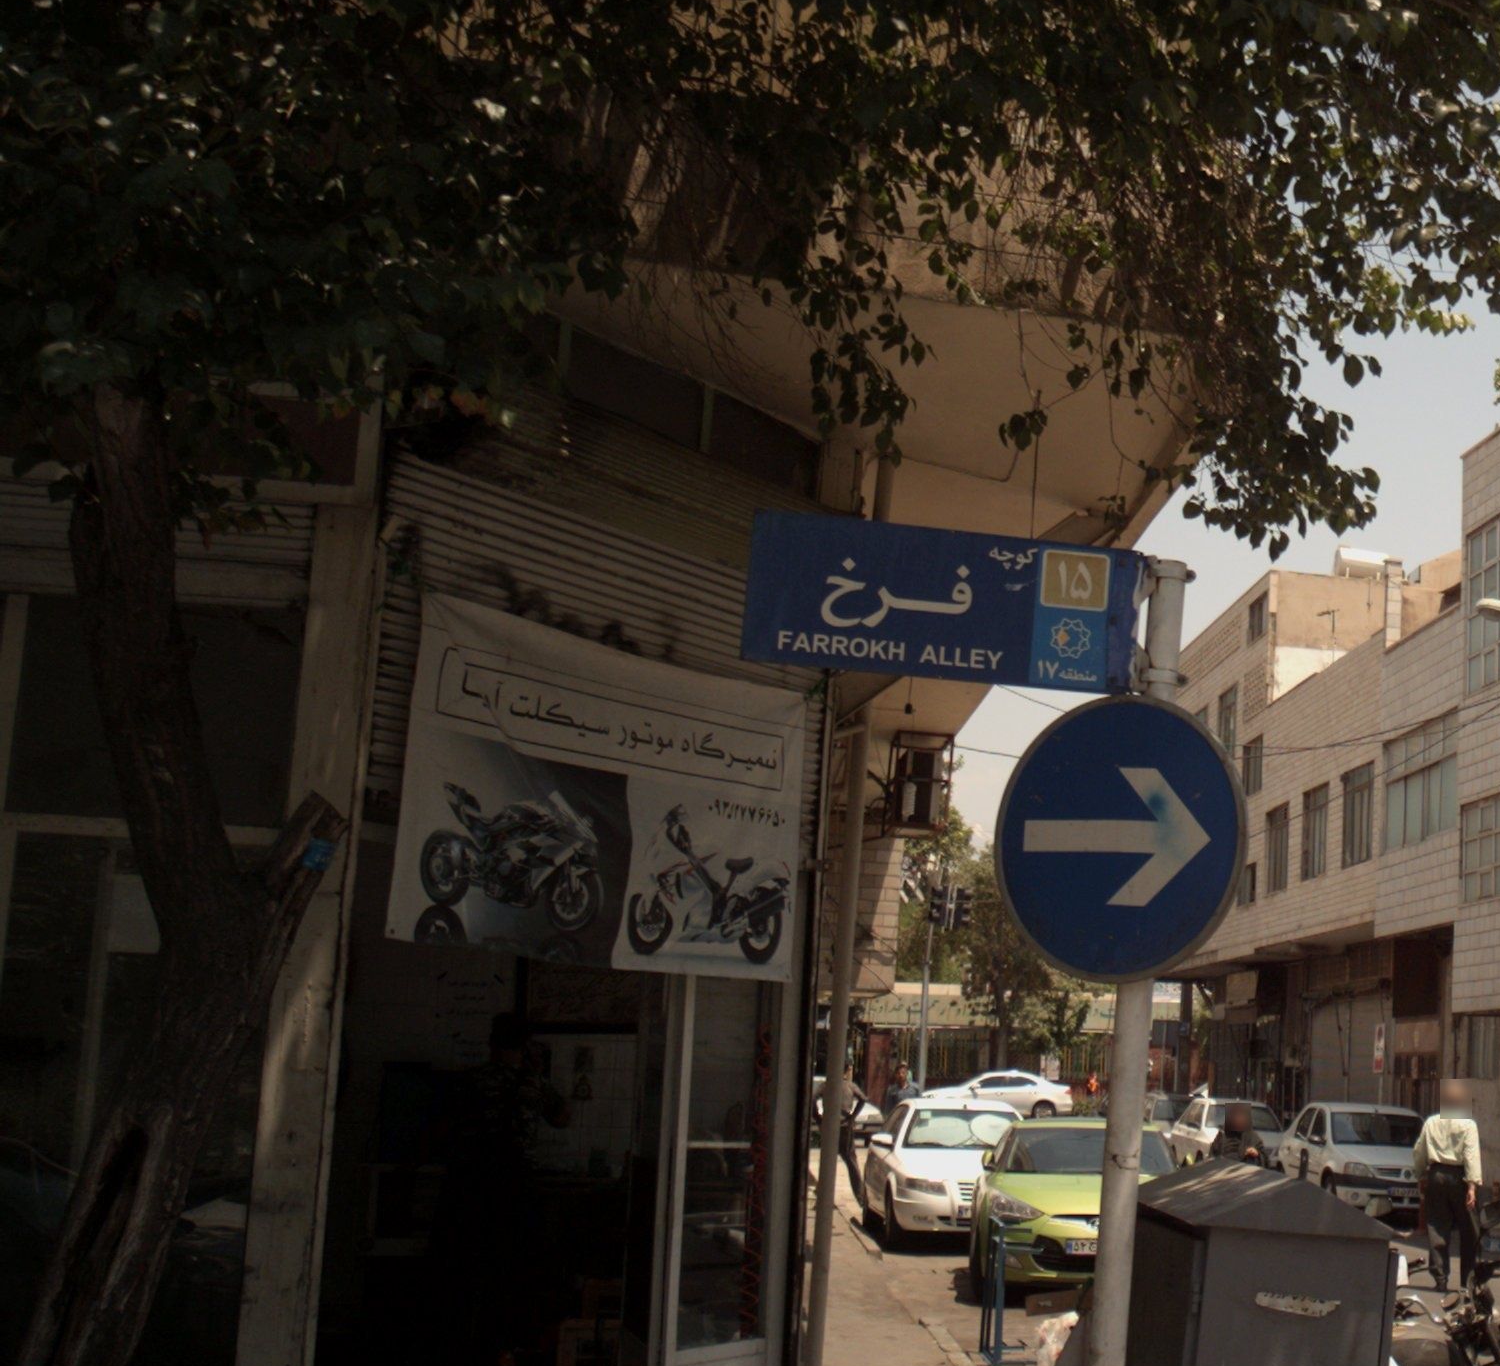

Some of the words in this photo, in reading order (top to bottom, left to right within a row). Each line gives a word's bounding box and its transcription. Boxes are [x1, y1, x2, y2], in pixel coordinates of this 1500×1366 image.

[988, 547, 1039, 571] کوچه
[821, 555, 973, 628] فرخ
[1058, 560, 1093, 600] ۱۵
[776, 630, 906, 663] FARROKH
[919, 642, 1004, 672] ALLEY
[1038, 658, 1059, 680] ۱۷
[509, 695, 610, 738] سیکلت
[619, 720, 674, 753] موتور
